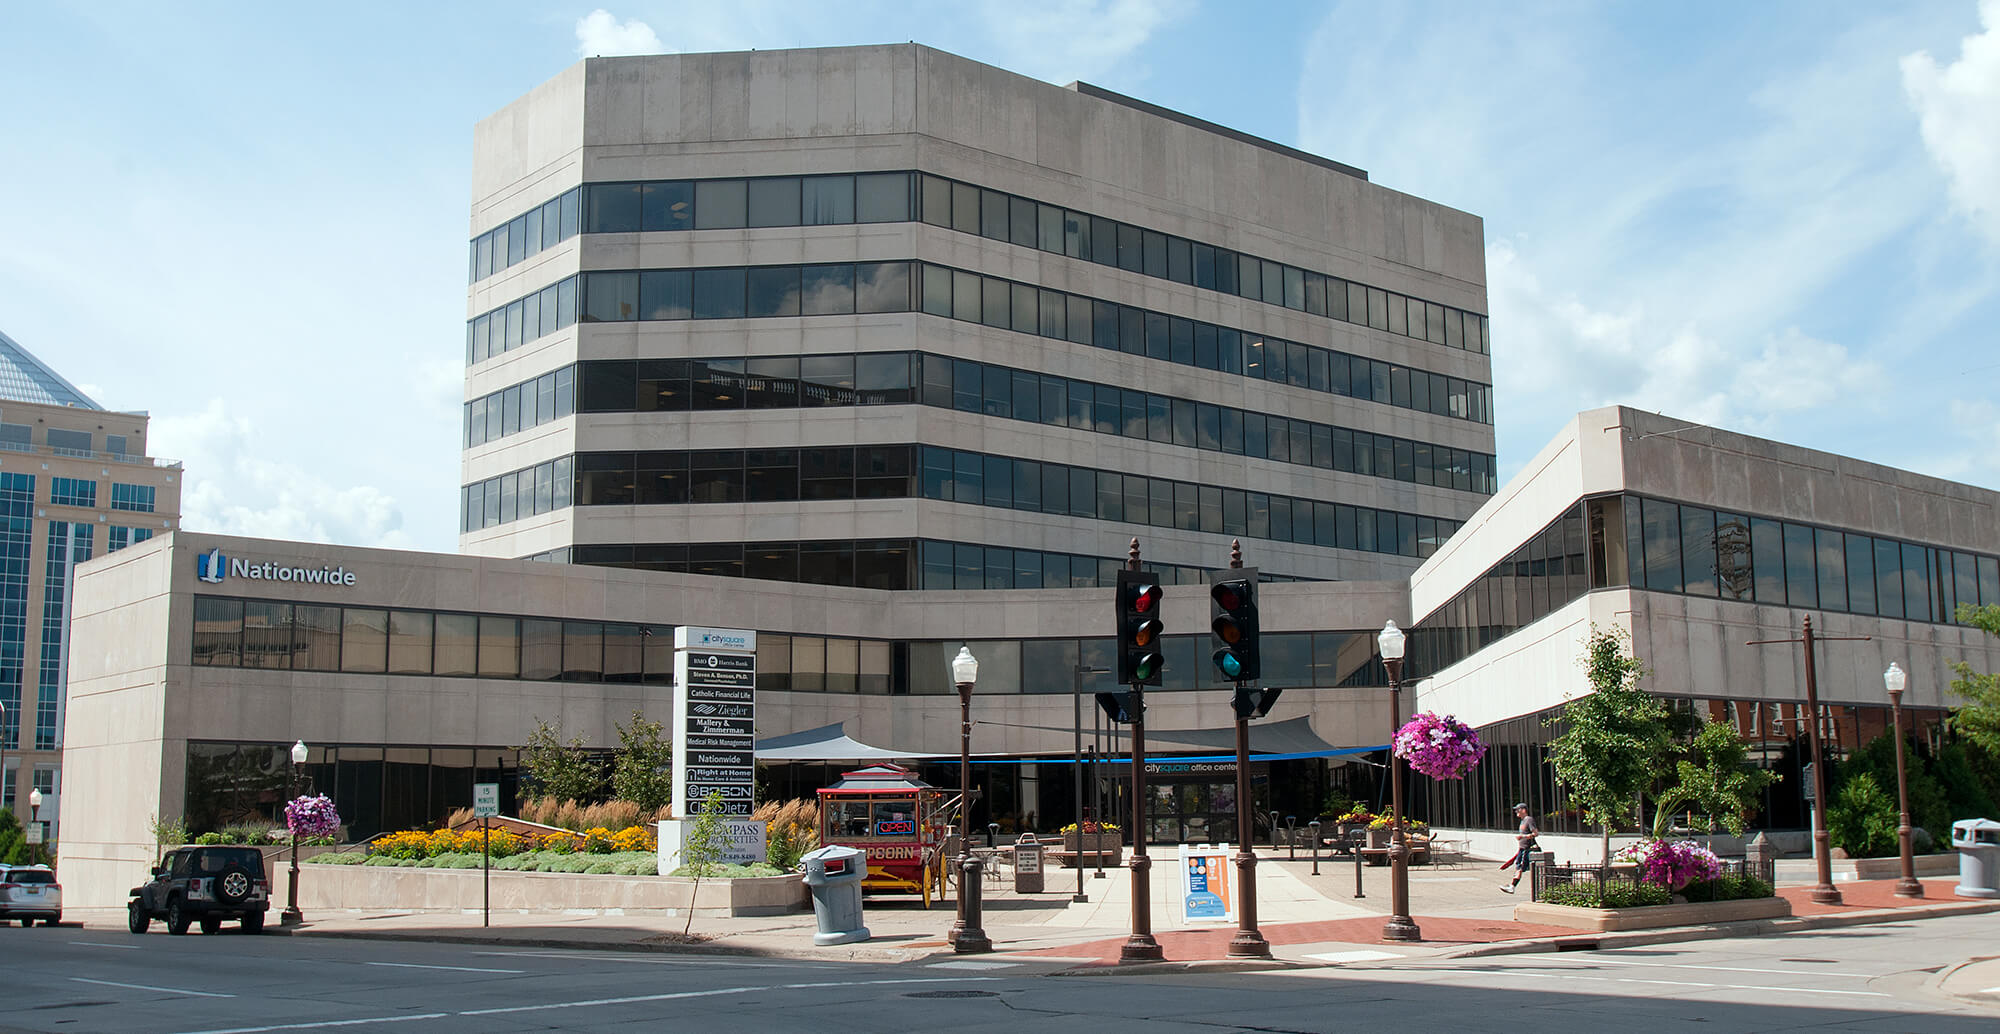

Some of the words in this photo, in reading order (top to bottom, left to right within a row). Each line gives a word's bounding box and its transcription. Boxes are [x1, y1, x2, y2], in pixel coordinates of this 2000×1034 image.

[230, 557, 357, 586] Nationwide
[711, 635, 745, 644] citysquare
[691, 689, 715, 698] Catholic
[715, 690, 740, 698] Financial
[740, 691, 751, 699] Life
[717, 704, 748, 716] Ziegler
[696, 718, 722, 728] Mallery
[723, 719, 730, 727] &
[703, 725, 745, 734] Zimmerman
[687, 737, 706, 745] Medical
[707, 738, 718, 746] Risk
[719, 738, 752, 748] Management
[698, 754, 741, 764] Nationwide
[697, 769, 719, 777] Right
[1144, 763, 1189, 773] citysquare
[1190, 763, 1212, 771] office
[483, 787, 490, 795] 15
[880, 822, 912, 833] OPEN
[852, 846, 914, 859] PCORN
